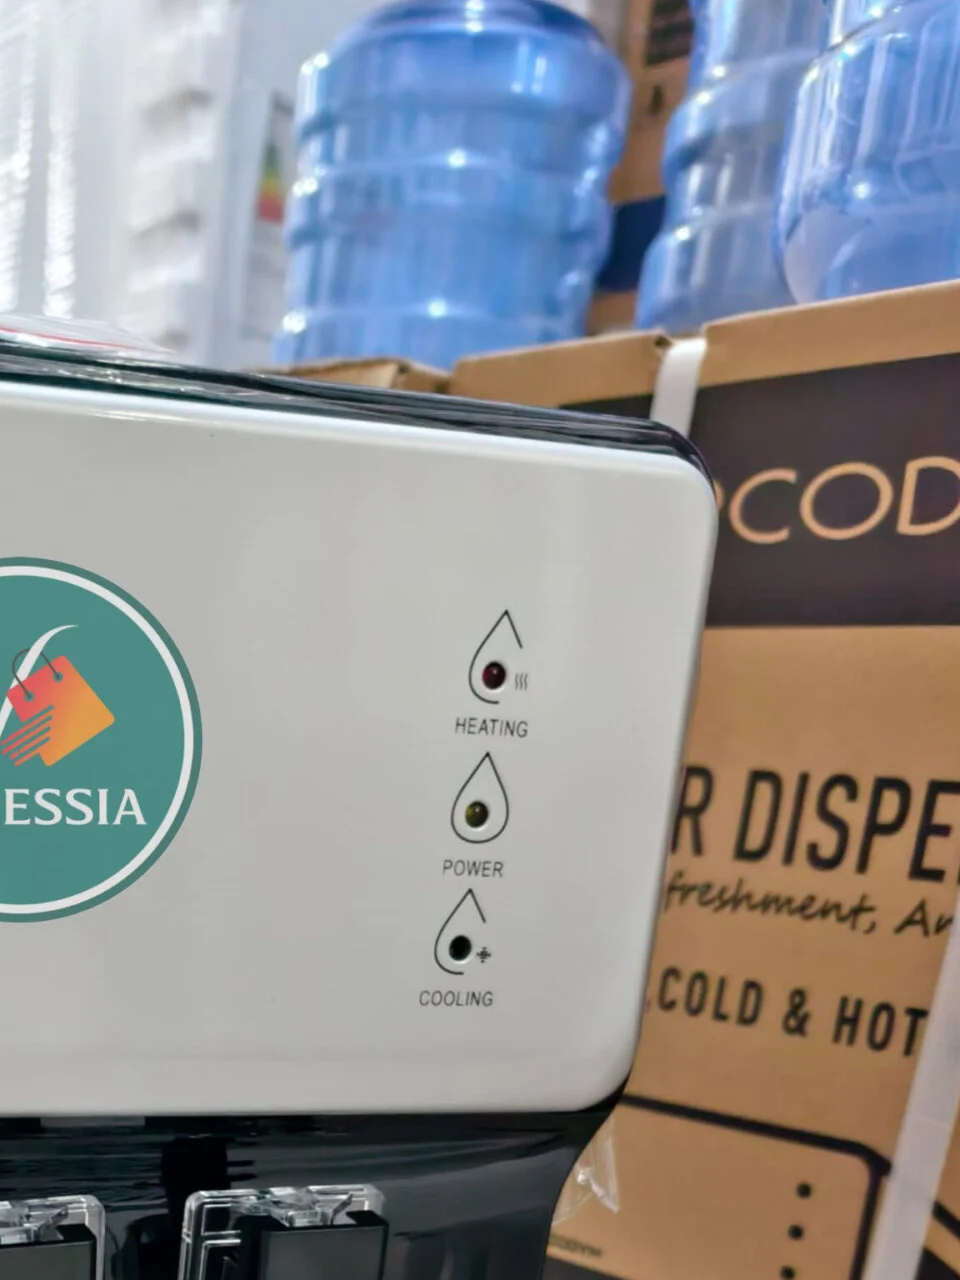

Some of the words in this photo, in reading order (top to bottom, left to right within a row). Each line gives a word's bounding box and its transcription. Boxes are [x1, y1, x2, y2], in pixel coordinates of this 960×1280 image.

[714, 456, 960, 544] COD
[455, 717, 528, 738] HEATING
[733, 767, 960, 884] DISPE
[442, 859, 504, 878] POWER
[419, 990, 494, 1007] COOLING
[781, 988, 811, 1038] &
[832, 995, 928, 1057] HOT
